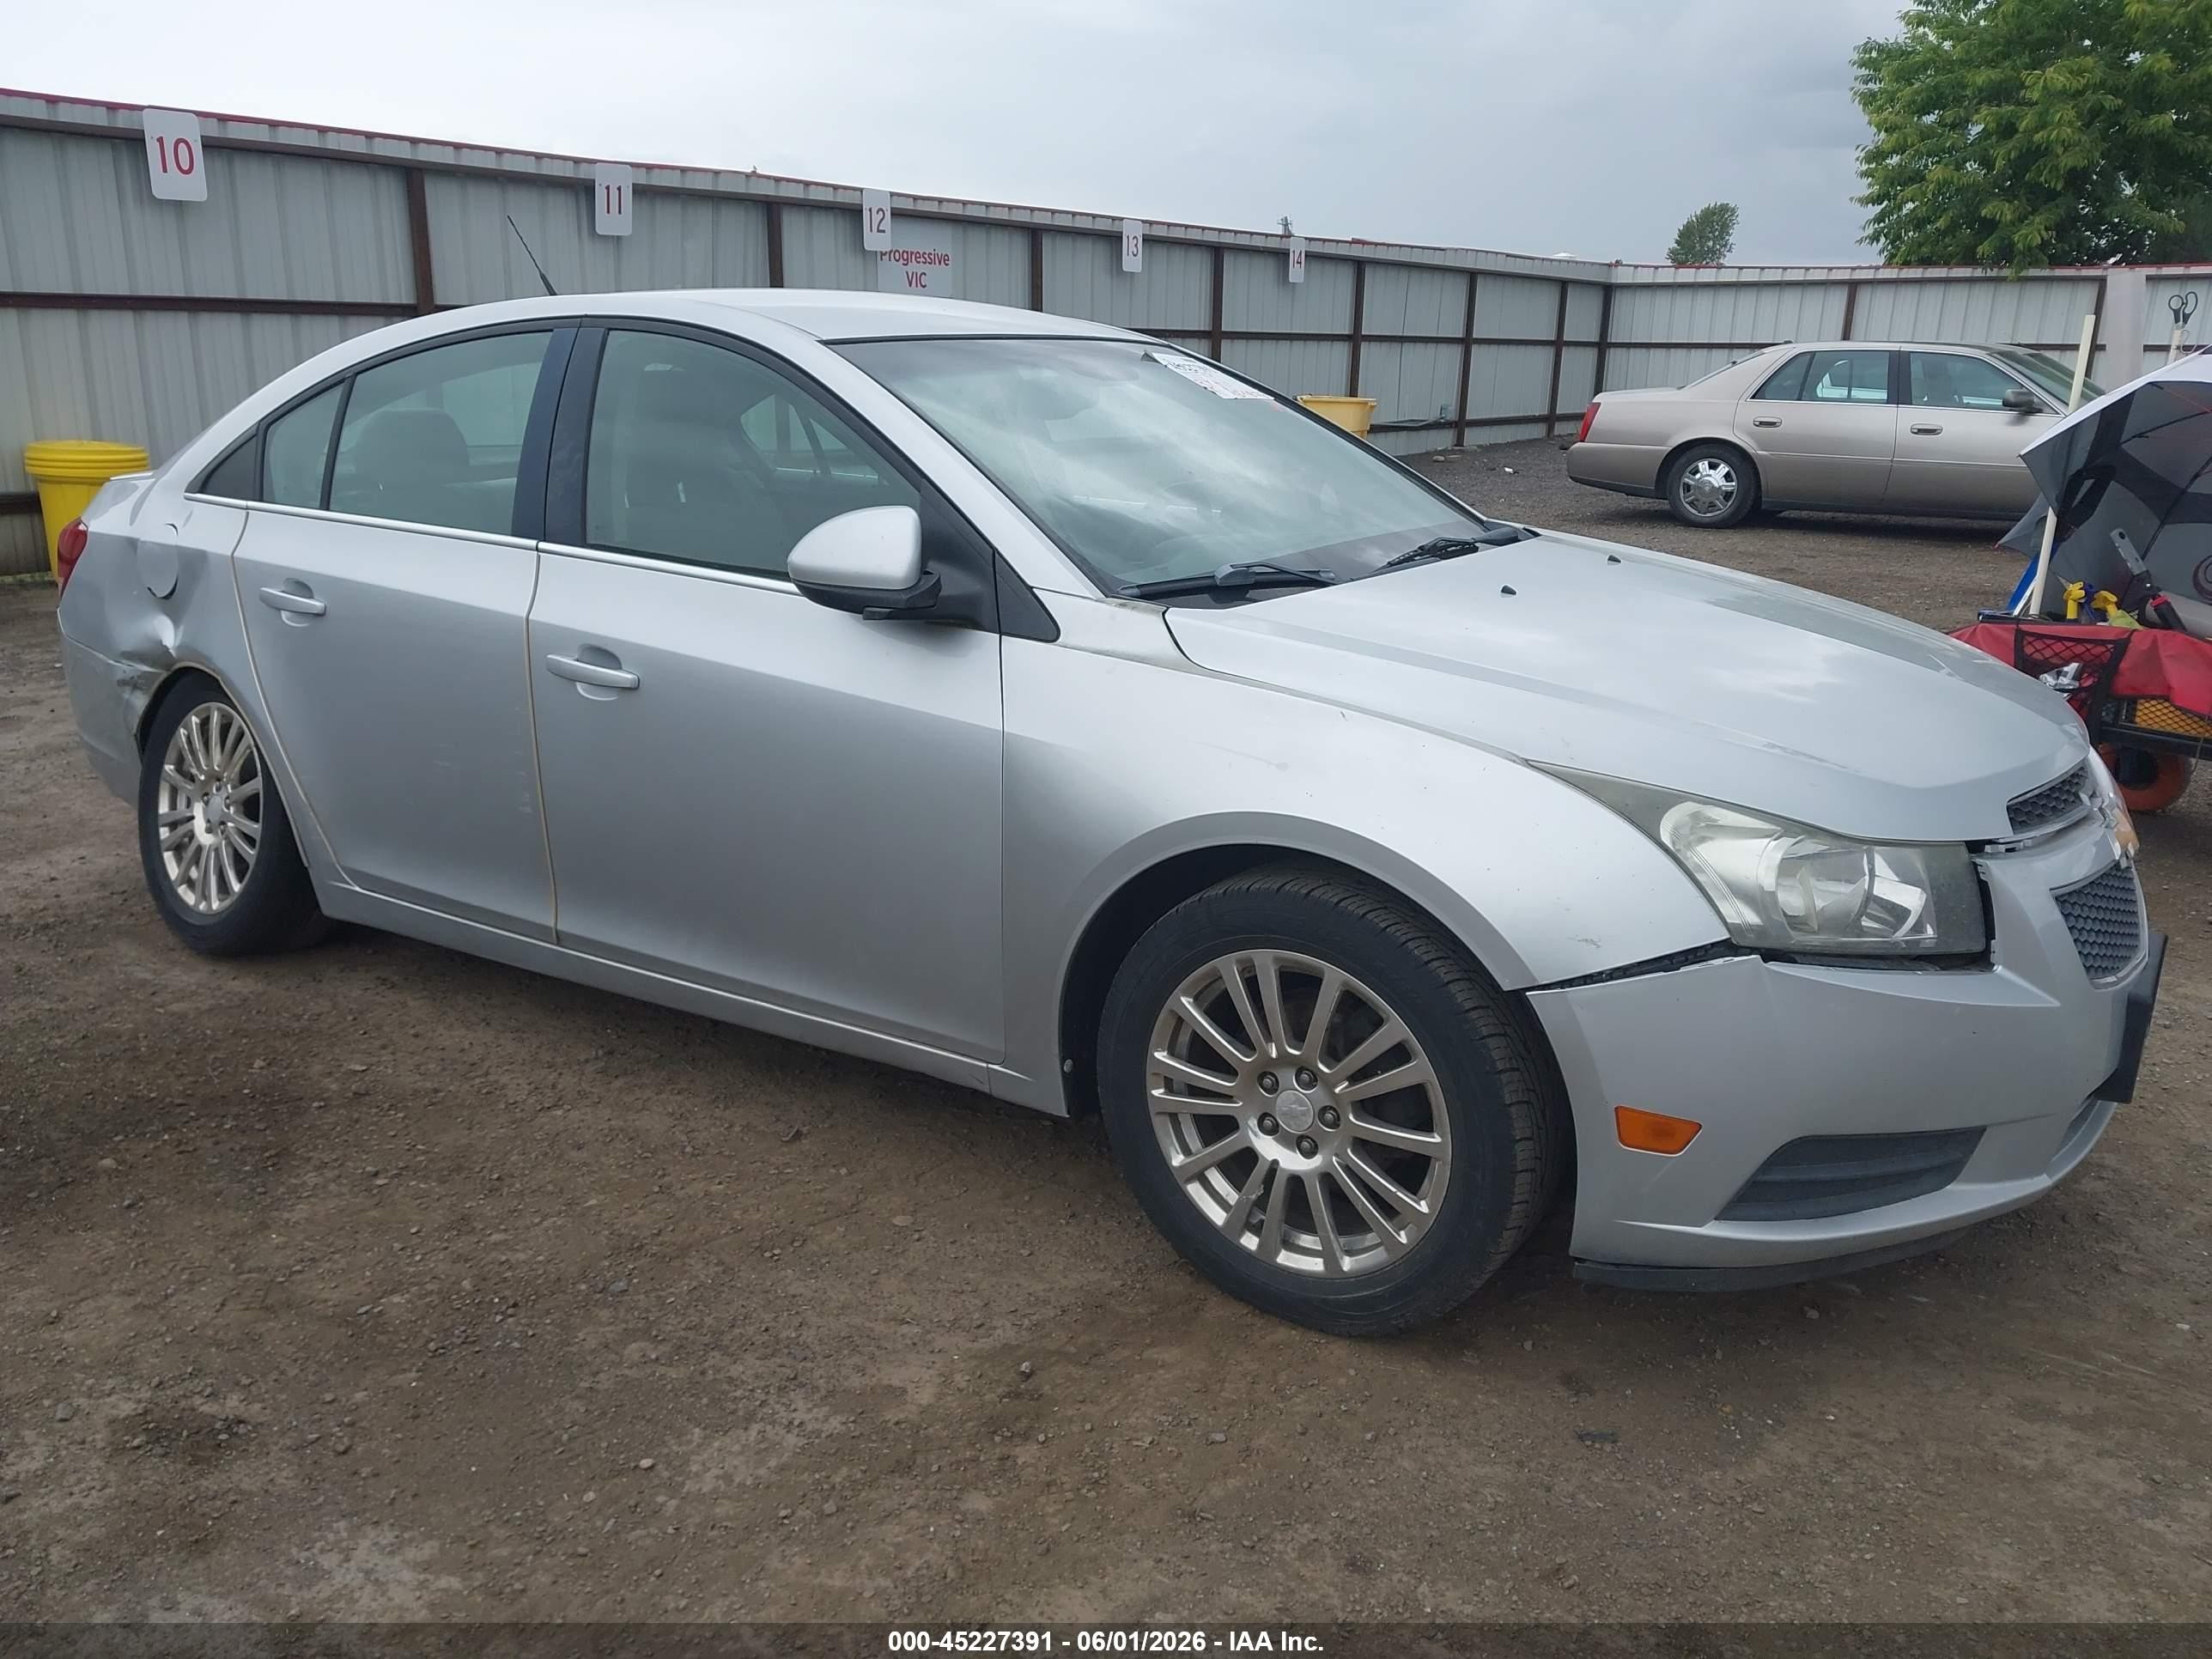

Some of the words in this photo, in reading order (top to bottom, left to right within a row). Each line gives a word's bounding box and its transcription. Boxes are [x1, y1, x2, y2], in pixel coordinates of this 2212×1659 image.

[156, 136, 195, 175] 10
[605, 185, 623, 215] 11
[868, 206, 886, 234] 12
[879, 248, 950, 266] Progressive
[1126, 234, 1139, 258] 13
[1292, 249, 1303, 269] 14
[905, 270, 927, 289] VIC
